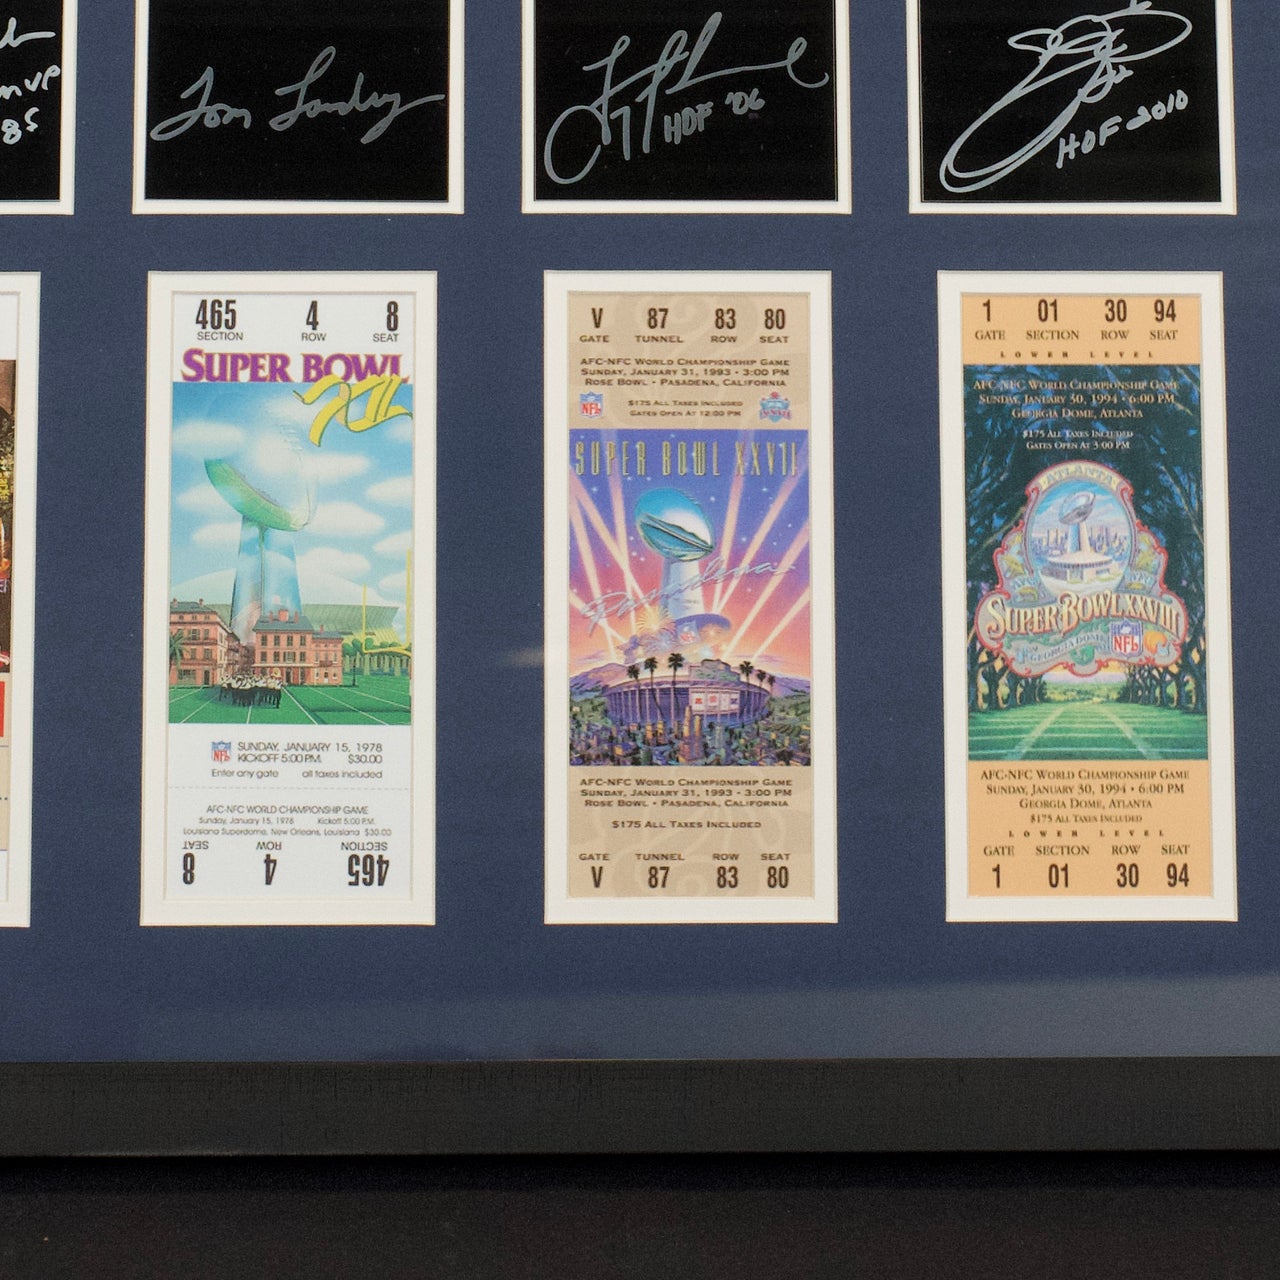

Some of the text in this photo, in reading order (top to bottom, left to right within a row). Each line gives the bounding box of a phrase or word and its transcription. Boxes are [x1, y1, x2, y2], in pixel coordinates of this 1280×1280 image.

[664, 101, 714, 144] HOF
[1056, 116, 1123, 169] HOF
[195, 300, 398, 331] 465 4 8
[592, 308, 786, 330] V 87 83 80
[983, 299, 1176, 322] 1 01 30 94
[197, 332, 399, 342] SECTION ROW SEAT
[579, 335, 610, 343] GATE
[635, 335, 684, 343] TUNNEL
[759, 336, 789, 344] SEAT
[975, 331, 1178, 340] GATE SECTION ROW SEAT
[181, 347, 410, 384] SUPER BOWL
[581, 403, 601, 415] NFL
[576, 441, 798, 476] SUPER BOWL XXVII
[986, 591, 1180, 639] SUPER BOWL XXVIII
[1113, 636, 1139, 653] NFL
[237, 742, 382, 753] SUNDAY, JANUARY 15, 1978
[237, 770, 255, 779] any
[257, 770, 279, 779] gate
[315, 770, 339, 778] taxes
[341, 770, 382, 778] included
[1037, 770, 1074, 779] WORLD
[1078, 770, 1156, 779] CHAMPIONSHIP
[1159, 771, 1189, 779] GAME
[612, 820, 641, 829] $175
[669, 821, 703, 829] TAXES
[707, 821, 761, 829] INCLUDED
[182, 841, 387, 851] SEAT ROW SECTION
[984, 845, 1190, 856] GATE SECTION ROW SEAT
[579, 853, 791, 861] GATE TUNNEL ROW SEAT
[183, 853, 389, 886] 8 4 465
[591, 866, 789, 888] V 87 83 80
[992, 863, 1189, 888] 1 01 30 94
